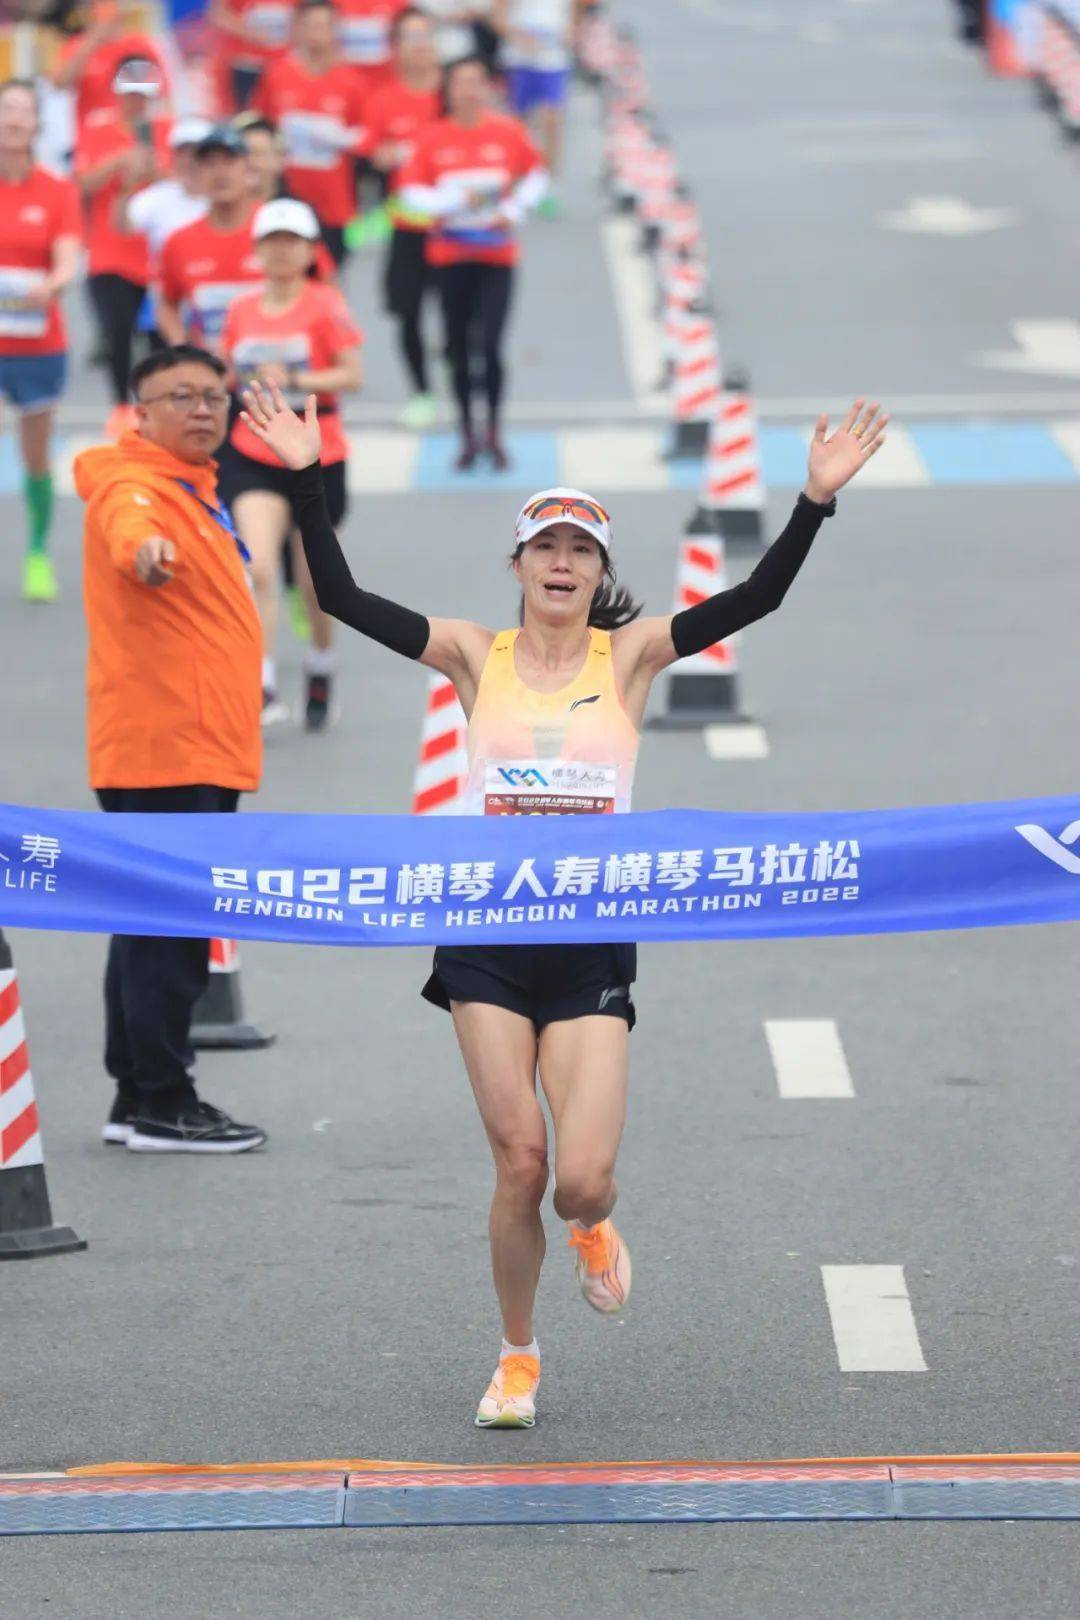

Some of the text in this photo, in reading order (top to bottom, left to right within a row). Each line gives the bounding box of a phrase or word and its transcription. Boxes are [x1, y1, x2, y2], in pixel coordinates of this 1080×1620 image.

[0, 833, 62, 869] 寿
[5, 868, 58, 892] LIFE
[210, 840, 861, 905] 2022横琴人寿横琴马拉松
[213, 885, 860, 929] HENGQIN LIFE HENGQIN MARATHON 2022
